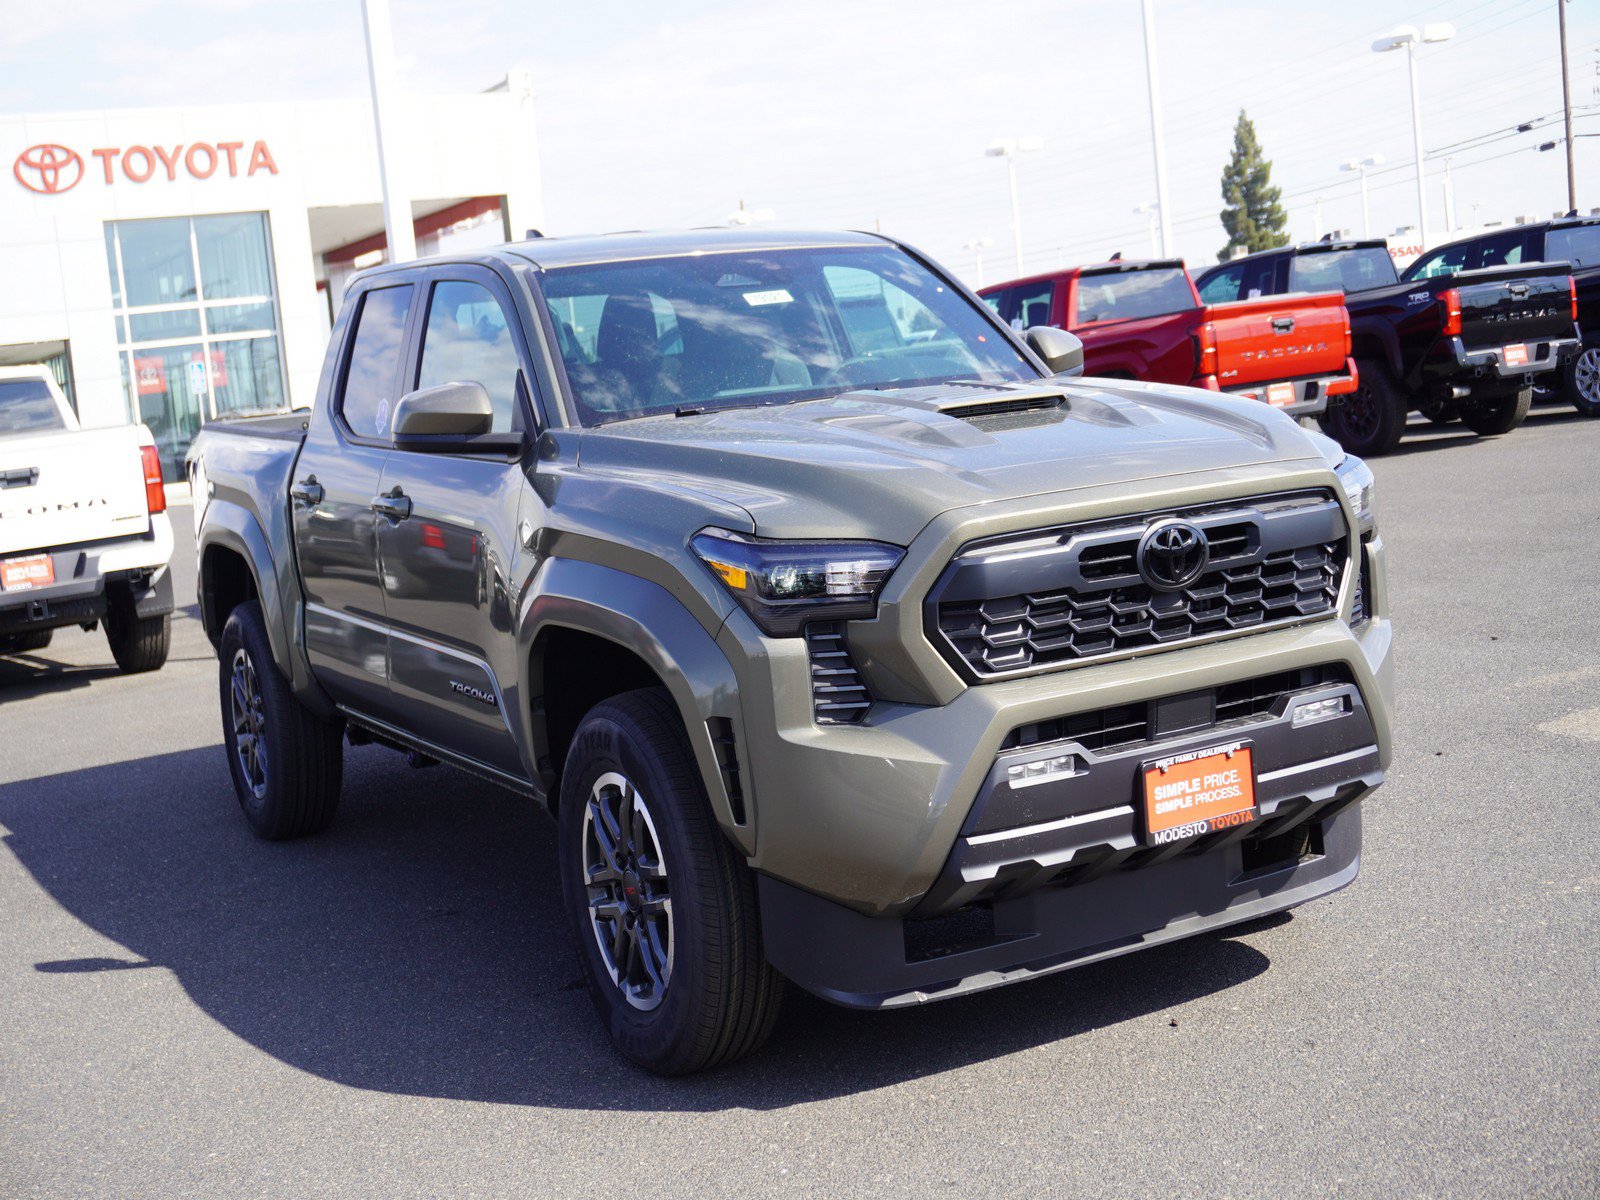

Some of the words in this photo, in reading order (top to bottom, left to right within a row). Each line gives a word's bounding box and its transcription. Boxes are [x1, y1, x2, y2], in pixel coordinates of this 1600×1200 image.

[92, 140, 279, 185] TOYOTA
[1388, 244, 1423, 257] SSAN
[1482, 308, 1557, 324] TACOMA
[1241, 343, 1328, 361] TACOMA
[449, 680, 496, 704] TACOMA
[1175, 752, 1198, 764] FAMILY
[1199, 743, 1241, 757] DEALERSHIPS
[1154, 778, 1201, 800] SIMPLE
[1204, 770, 1241, 789] PRICE.
[1155, 796, 1193, 815] SIMPLE
[1195, 785, 1242, 805] PROCESS.
[1154, 822, 1207, 845] MODESTO
[1209, 811, 1253, 831] TOYOTA
